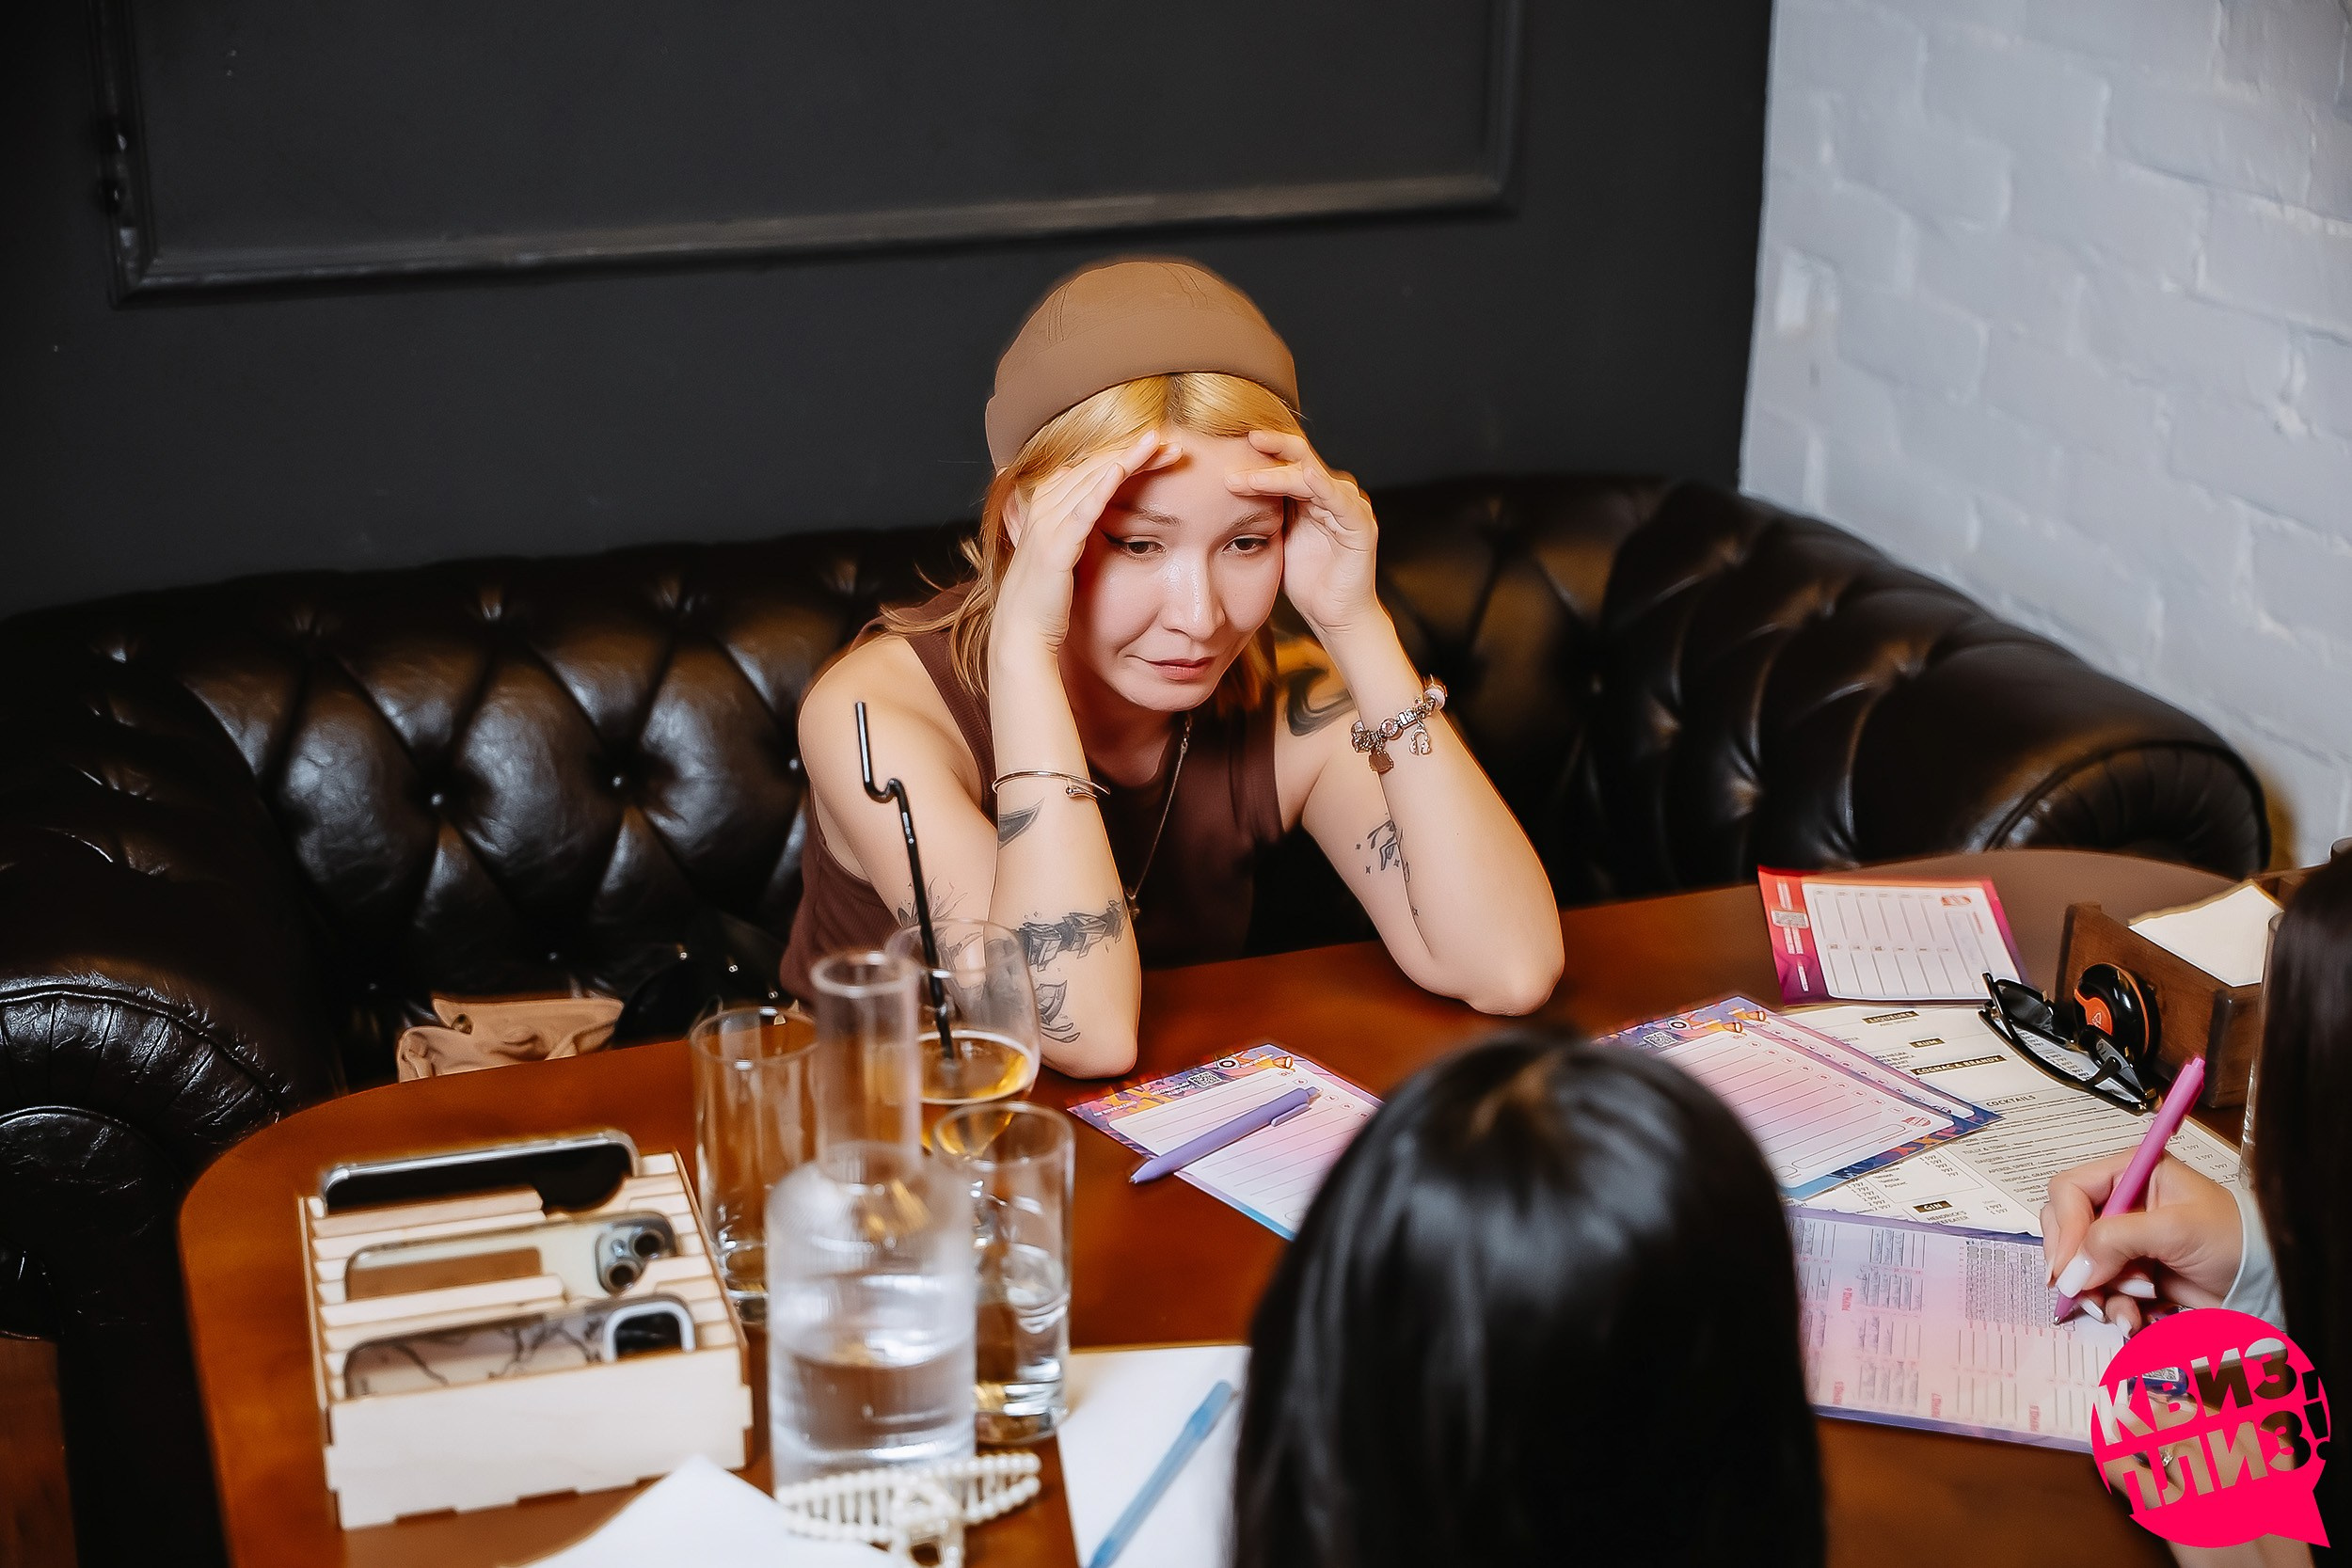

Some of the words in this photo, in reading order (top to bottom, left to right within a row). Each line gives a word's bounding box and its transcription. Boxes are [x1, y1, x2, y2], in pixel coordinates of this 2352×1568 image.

[1916, 1064, 1953, 1075] COGNAC
[1963, 1056, 2000, 1068] BRANDY
[1986, 1095, 2036, 1107] COCKTAILS
